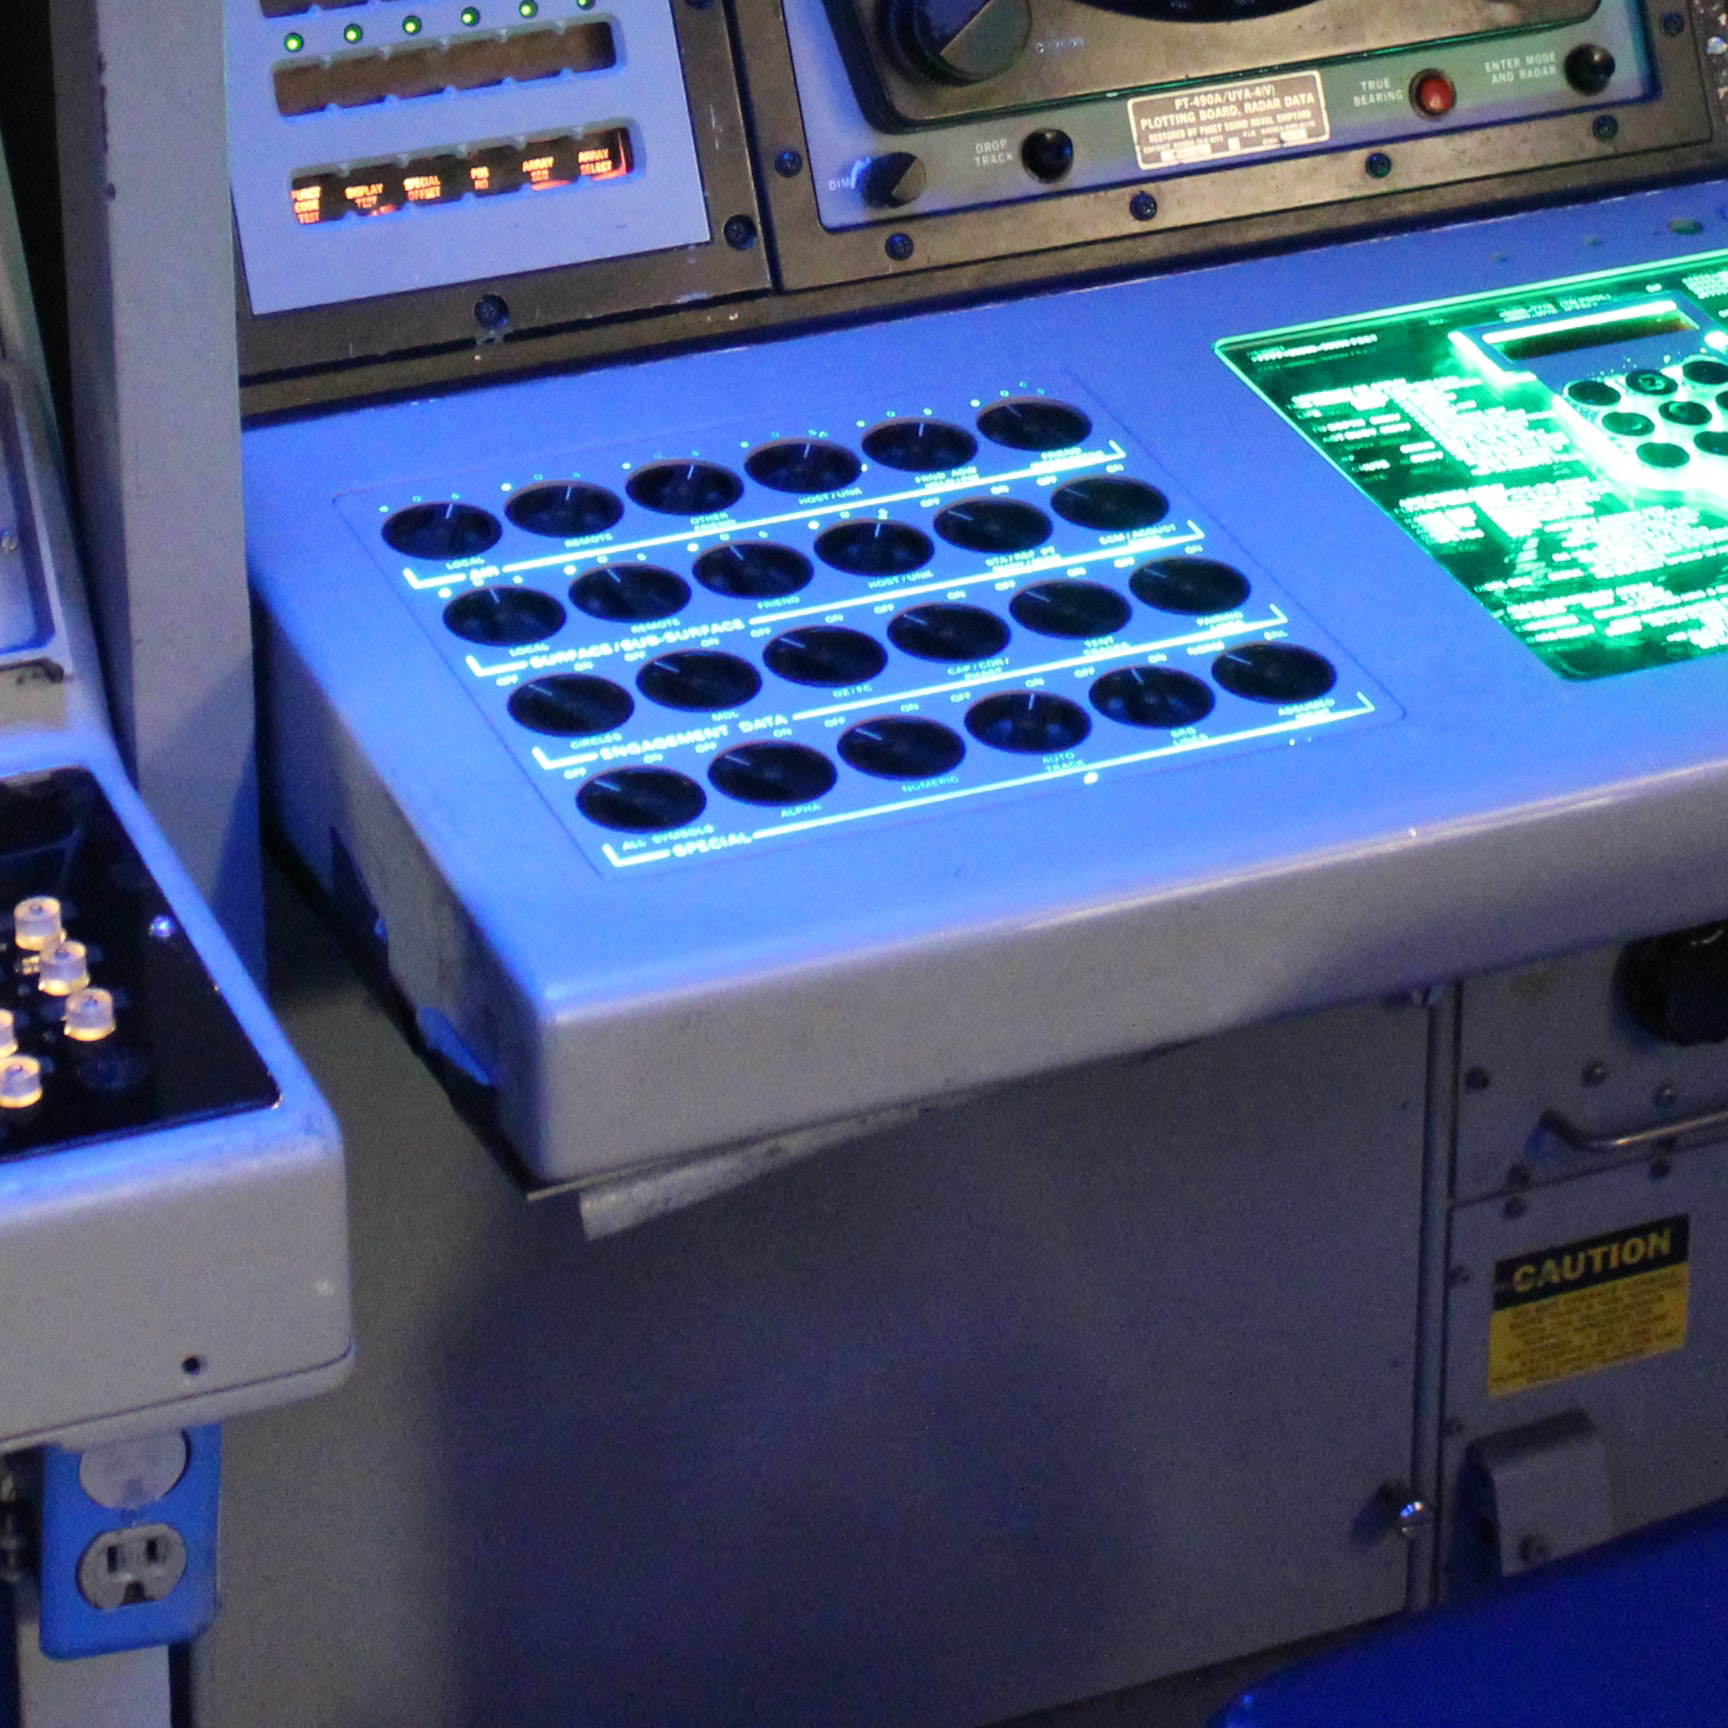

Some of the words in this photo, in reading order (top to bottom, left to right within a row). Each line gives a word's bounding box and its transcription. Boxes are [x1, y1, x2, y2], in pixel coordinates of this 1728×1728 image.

[1484, 55, 1521, 73] ENTER
[1524, 50, 1557, 69] MODE
[1490, 70, 1515, 85] AND
[1518, 64, 1558, 82] RADAR
[1359, 76, 1392, 92] TRUE
[1352, 89, 1404, 109] BEARING
[1139, 112, 1197, 131] PLOTTING
[1199, 104, 1243, 122] BOARD,
[1243, 97, 1282, 115] RADAR
[1284, 91, 1316, 107] DATA
[975, 138, 1008, 154] DROP
[578, 148, 610, 163] ARRAY
[974, 152, 1014, 168] TRACK
[522, 156, 555, 172] ARRAY
[580, 160, 613, 175] SELECT
[403, 175, 441, 191] SPECIAL
[444, 556, 486, 571] LOCAL
[508, 643, 551, 658] LOCAL
[569, 732, 624, 750] CIRCLES
[599, 724, 730, 761] ENGAGEMENT
[738, 712, 790, 735] DATA
[1041, 751, 1077, 765] AUTO
[901, 774, 961, 793] NUMERIC
[779, 803, 823, 819] ALPHA
[621, 839, 648, 852] ALL
[651, 824, 716, 845] SYMBOLS
[671, 833, 754, 859] SPECIAL
[1511, 1226, 1672, 1294] CAUTION
